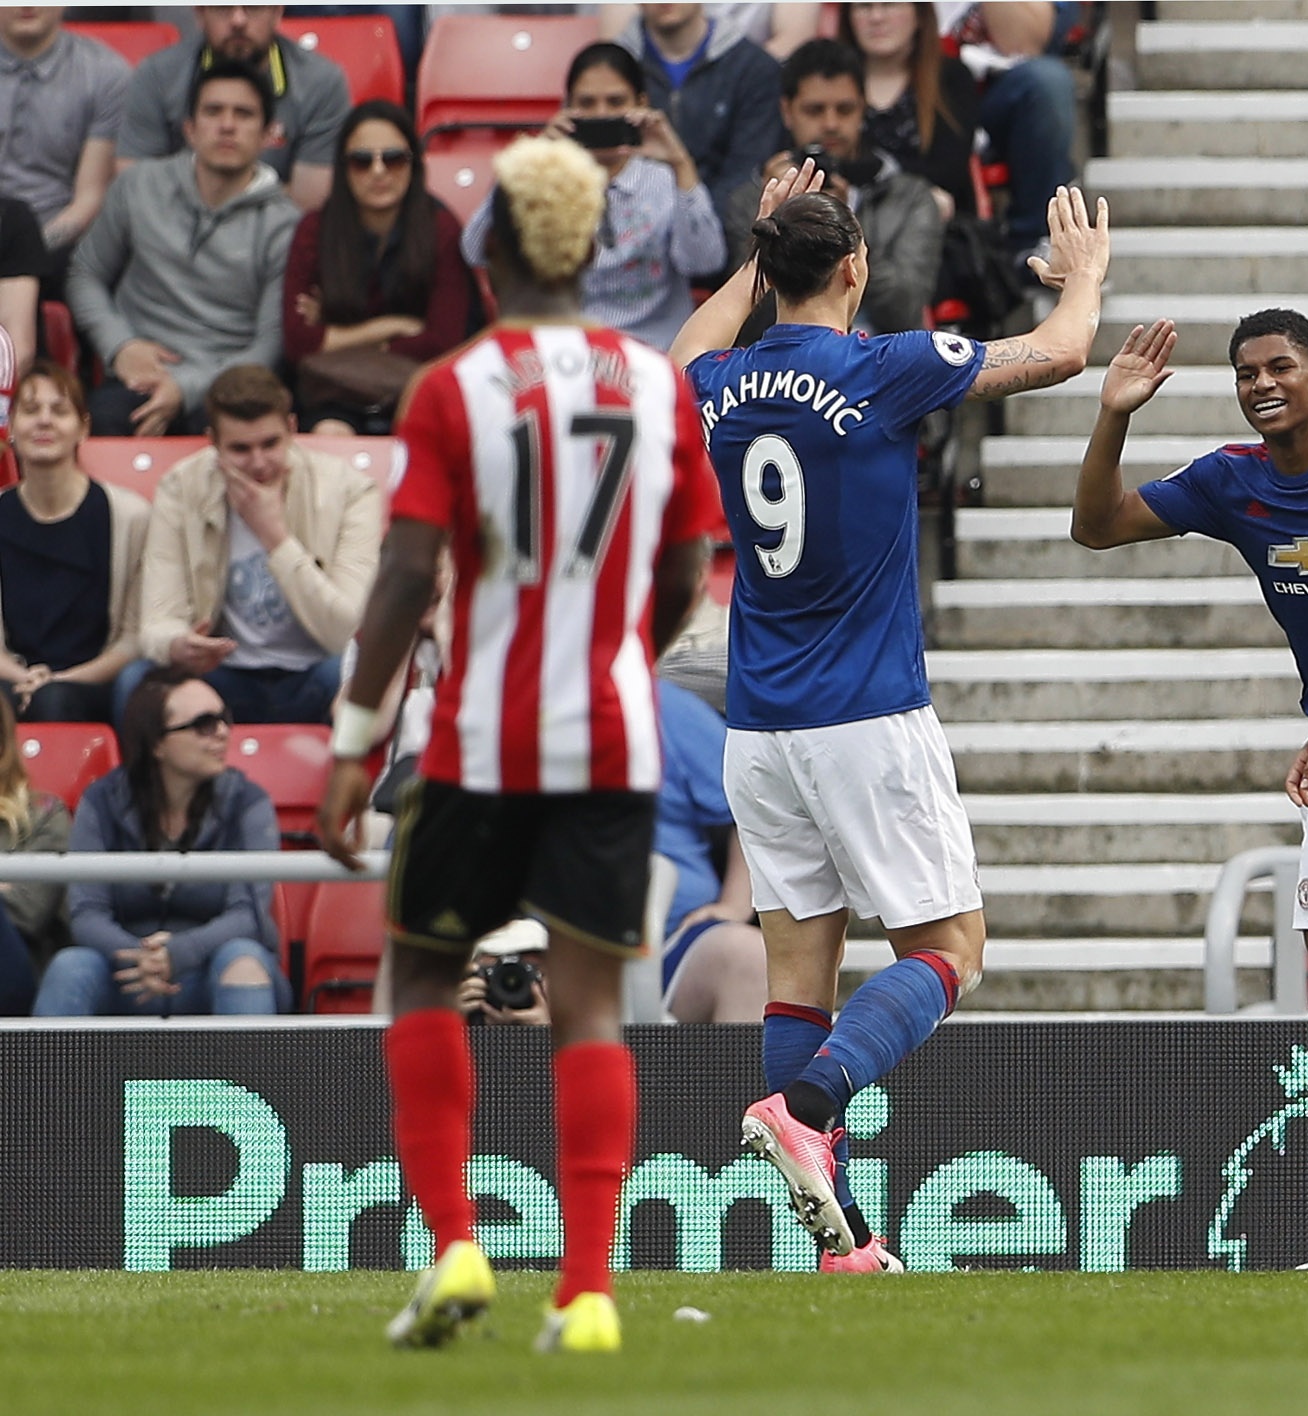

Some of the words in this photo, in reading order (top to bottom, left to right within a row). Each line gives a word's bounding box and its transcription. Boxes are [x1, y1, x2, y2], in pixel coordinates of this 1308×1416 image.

[510, 409, 639, 580] 17
[742, 433, 806, 579] 9
[124, 1078, 1184, 1272] Premier
